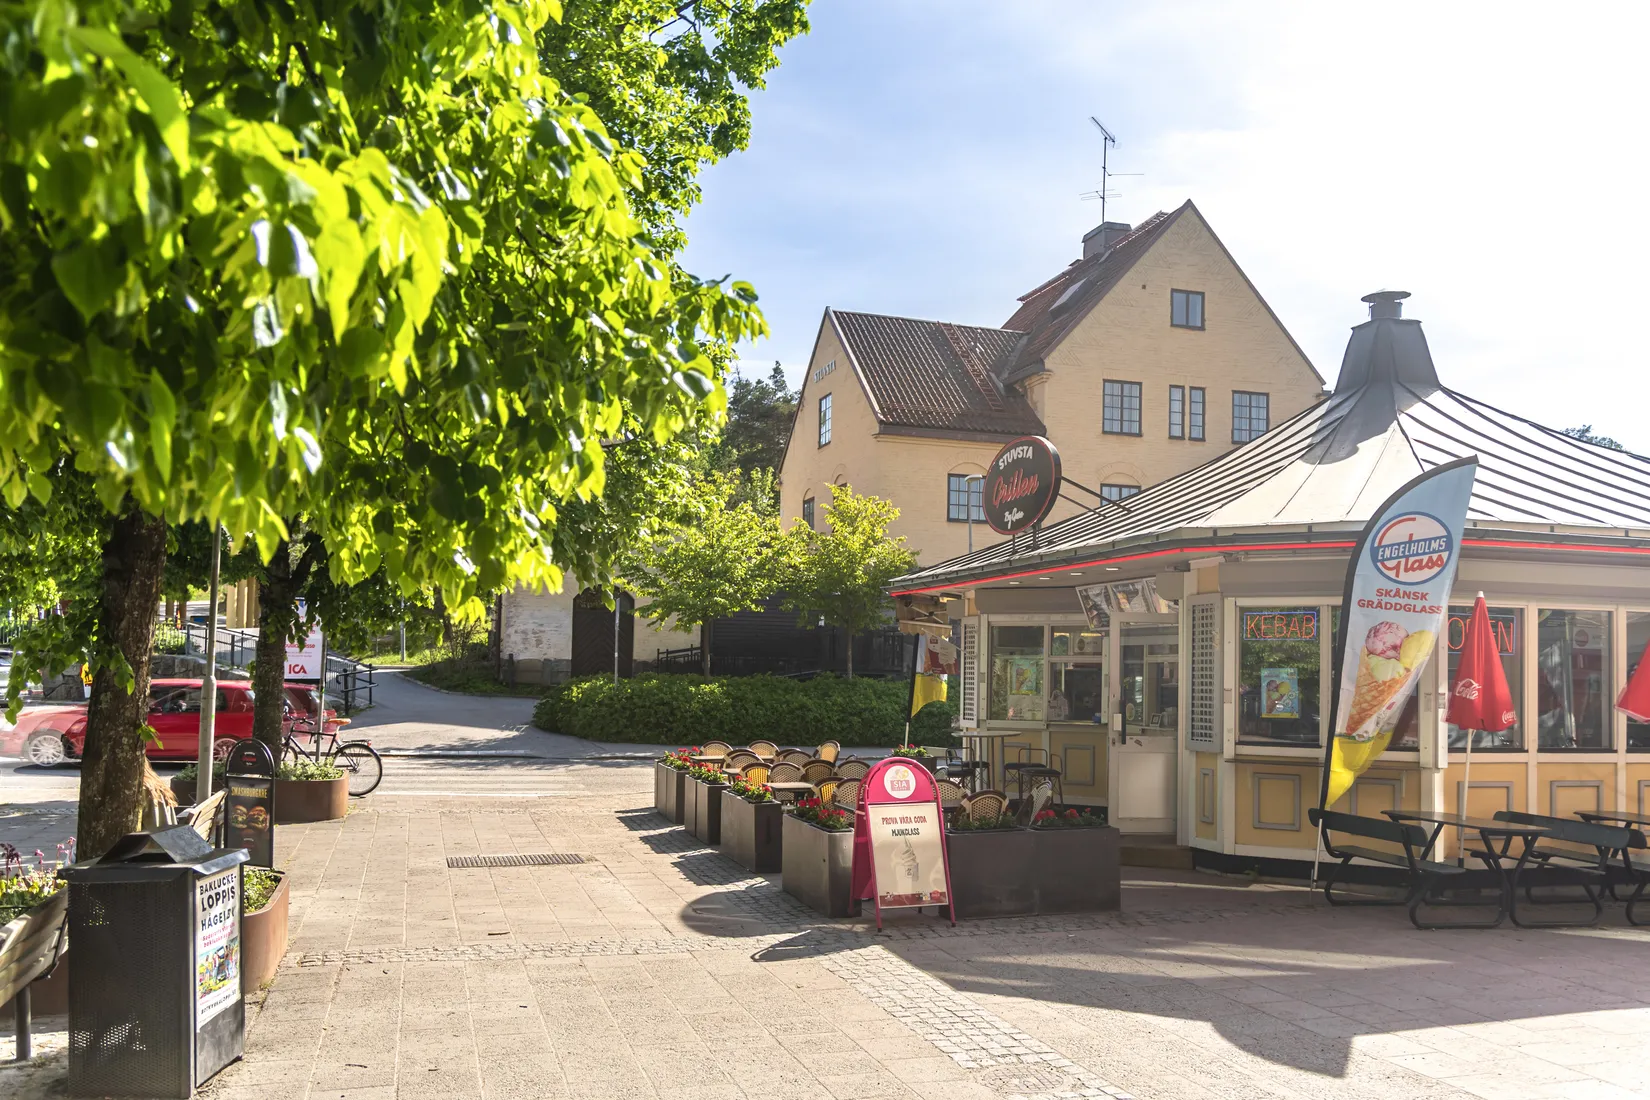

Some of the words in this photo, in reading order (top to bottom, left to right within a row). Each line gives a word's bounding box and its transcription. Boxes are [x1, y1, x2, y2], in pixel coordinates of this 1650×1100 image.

[999, 446, 1033, 470] STUVSTA
[993, 468, 1039, 508] Grillen
[1377, 517, 1445, 578] Glass
[1378, 538, 1446, 560] ENGELHOLMS
[1376, 588, 1429, 601] SKÅNSK
[1357, 599, 1443, 615] GRÄDDGLASS
[1247, 615, 1315, 639] KEBAB
[1448, 617, 1513, 653] ON
[288, 664, 307, 674] ICA
[893, 780, 907, 788] SIA
[881, 817, 898, 825] PROVA
[898, 815, 913, 825] VÅRA
[200, 873, 237, 896] BAKLUCKE-
[201, 886, 236, 912] LOPPIS
